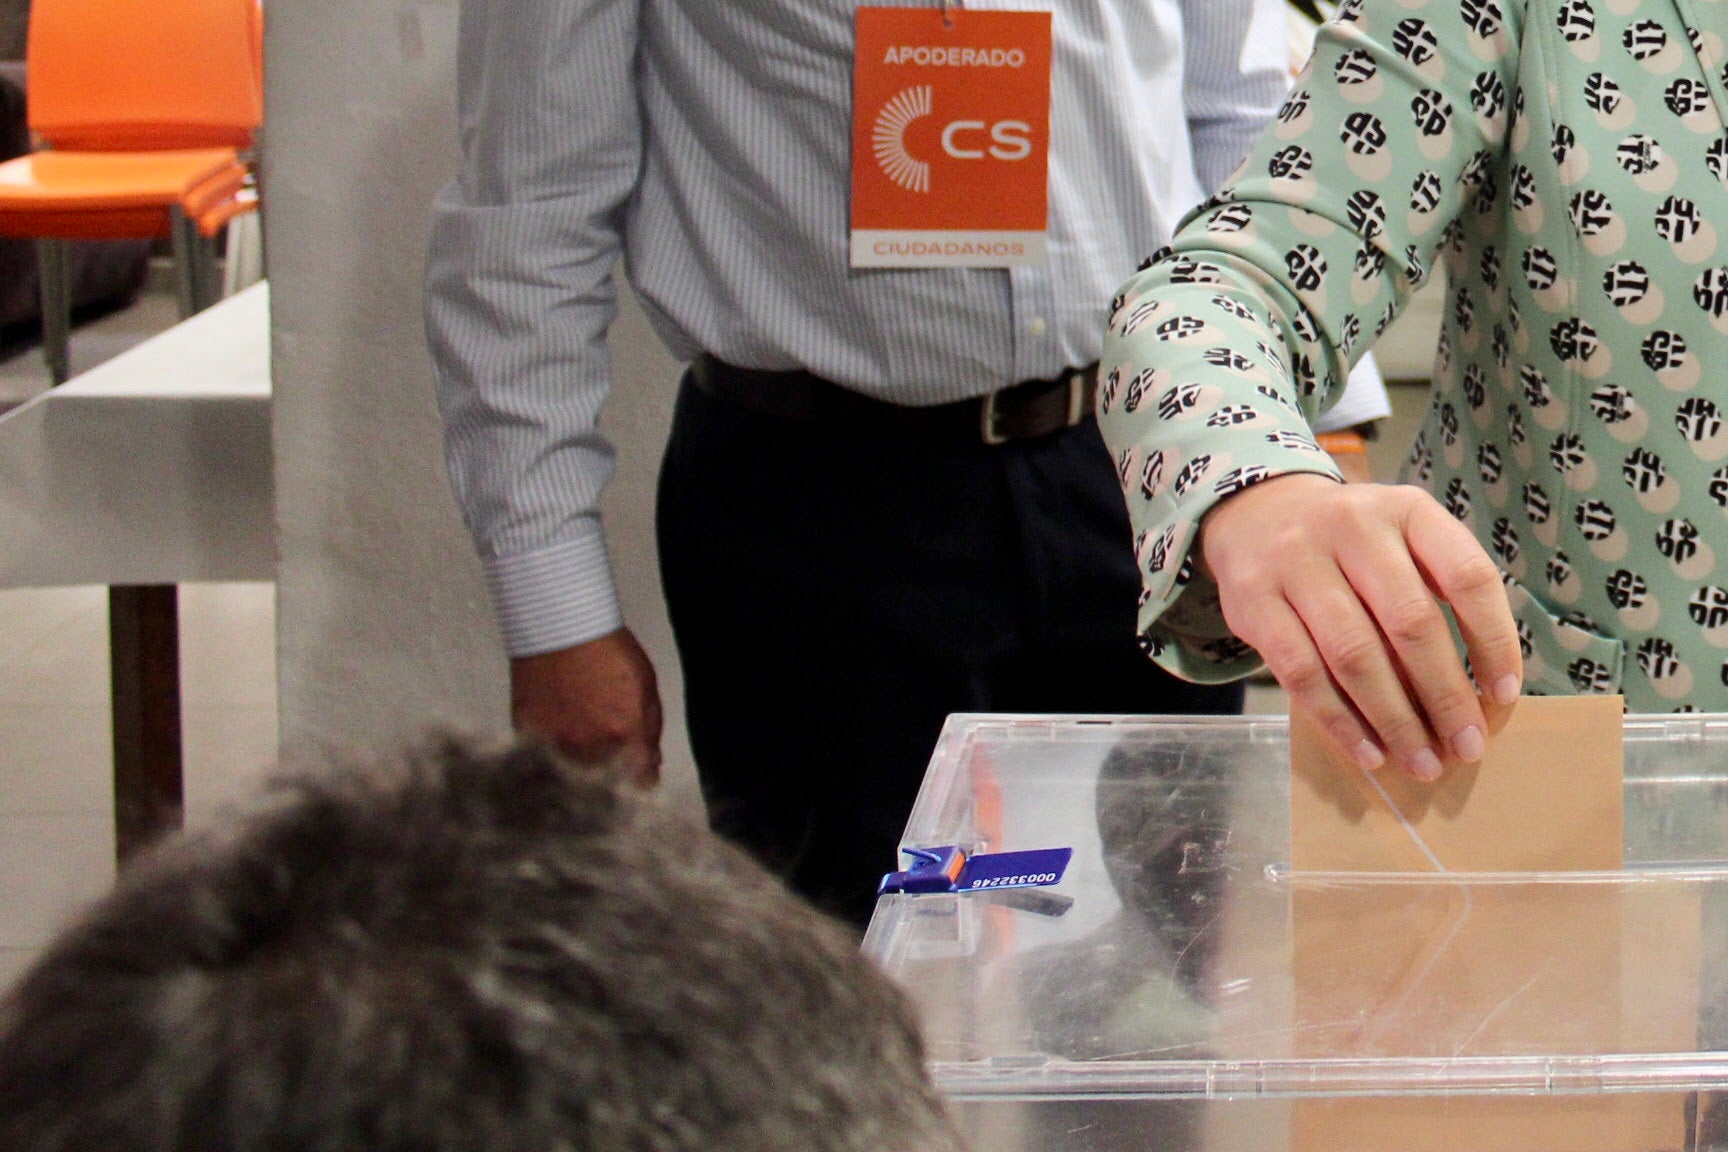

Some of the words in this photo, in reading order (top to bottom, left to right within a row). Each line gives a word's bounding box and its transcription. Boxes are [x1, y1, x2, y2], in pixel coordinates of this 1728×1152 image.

[884, 46, 1025, 68] APODERADO
[941, 120, 1032, 161] CS
[873, 241, 1025, 257] CIUDADANOS
[972, 873, 1056, 888] 000332246
